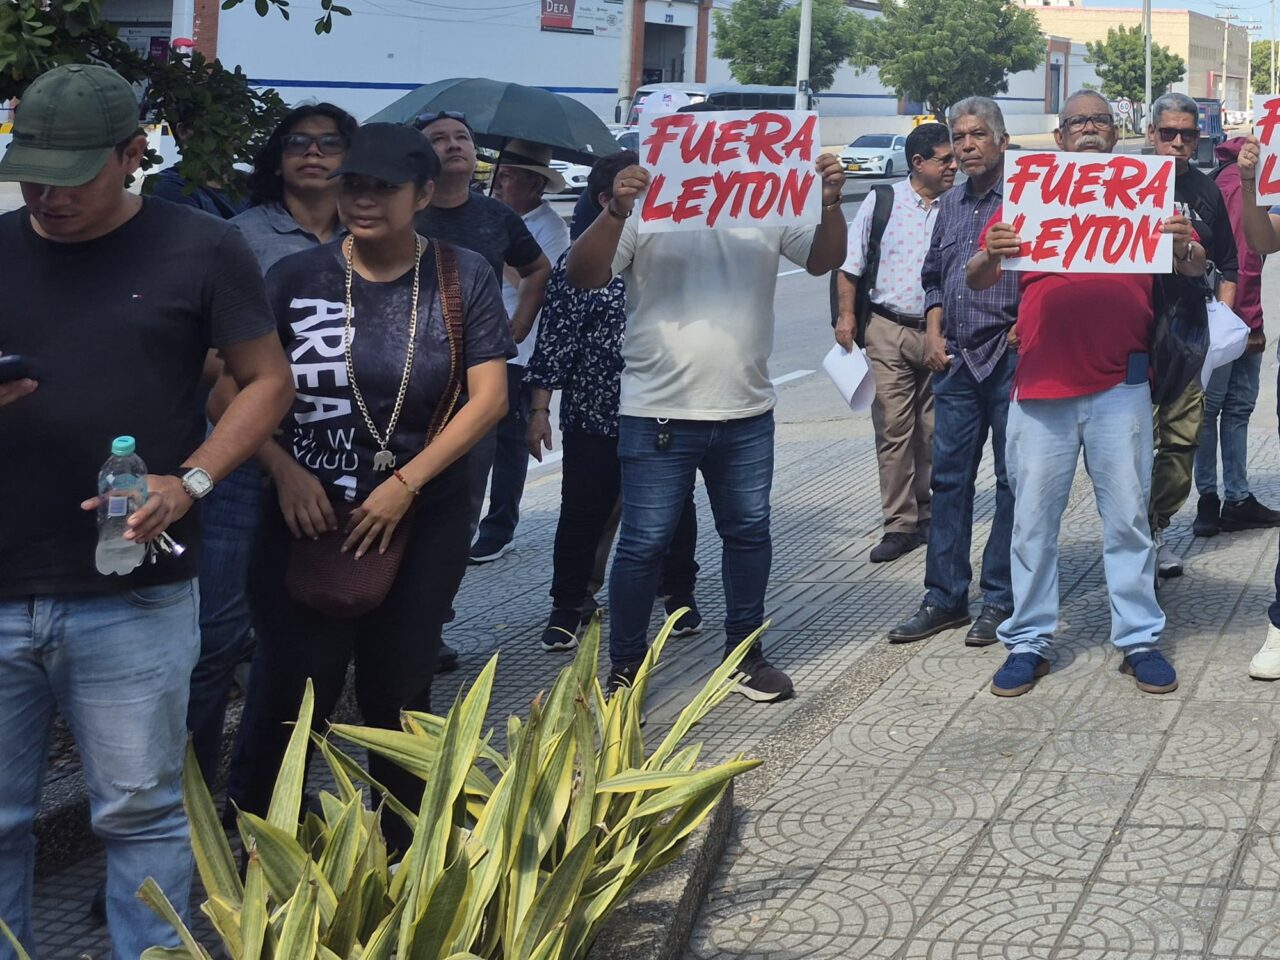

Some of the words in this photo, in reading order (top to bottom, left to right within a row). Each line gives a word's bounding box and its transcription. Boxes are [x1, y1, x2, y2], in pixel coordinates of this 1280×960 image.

[546, 0, 569, 14] DEFA
[648, 112, 815, 164] FUERA
[643, 170, 812, 223] LEYTON
[1008, 154, 1173, 210] FUERA
[1005, 215, 1163, 269] LEYTON
[290, 297, 355, 425] AREA
